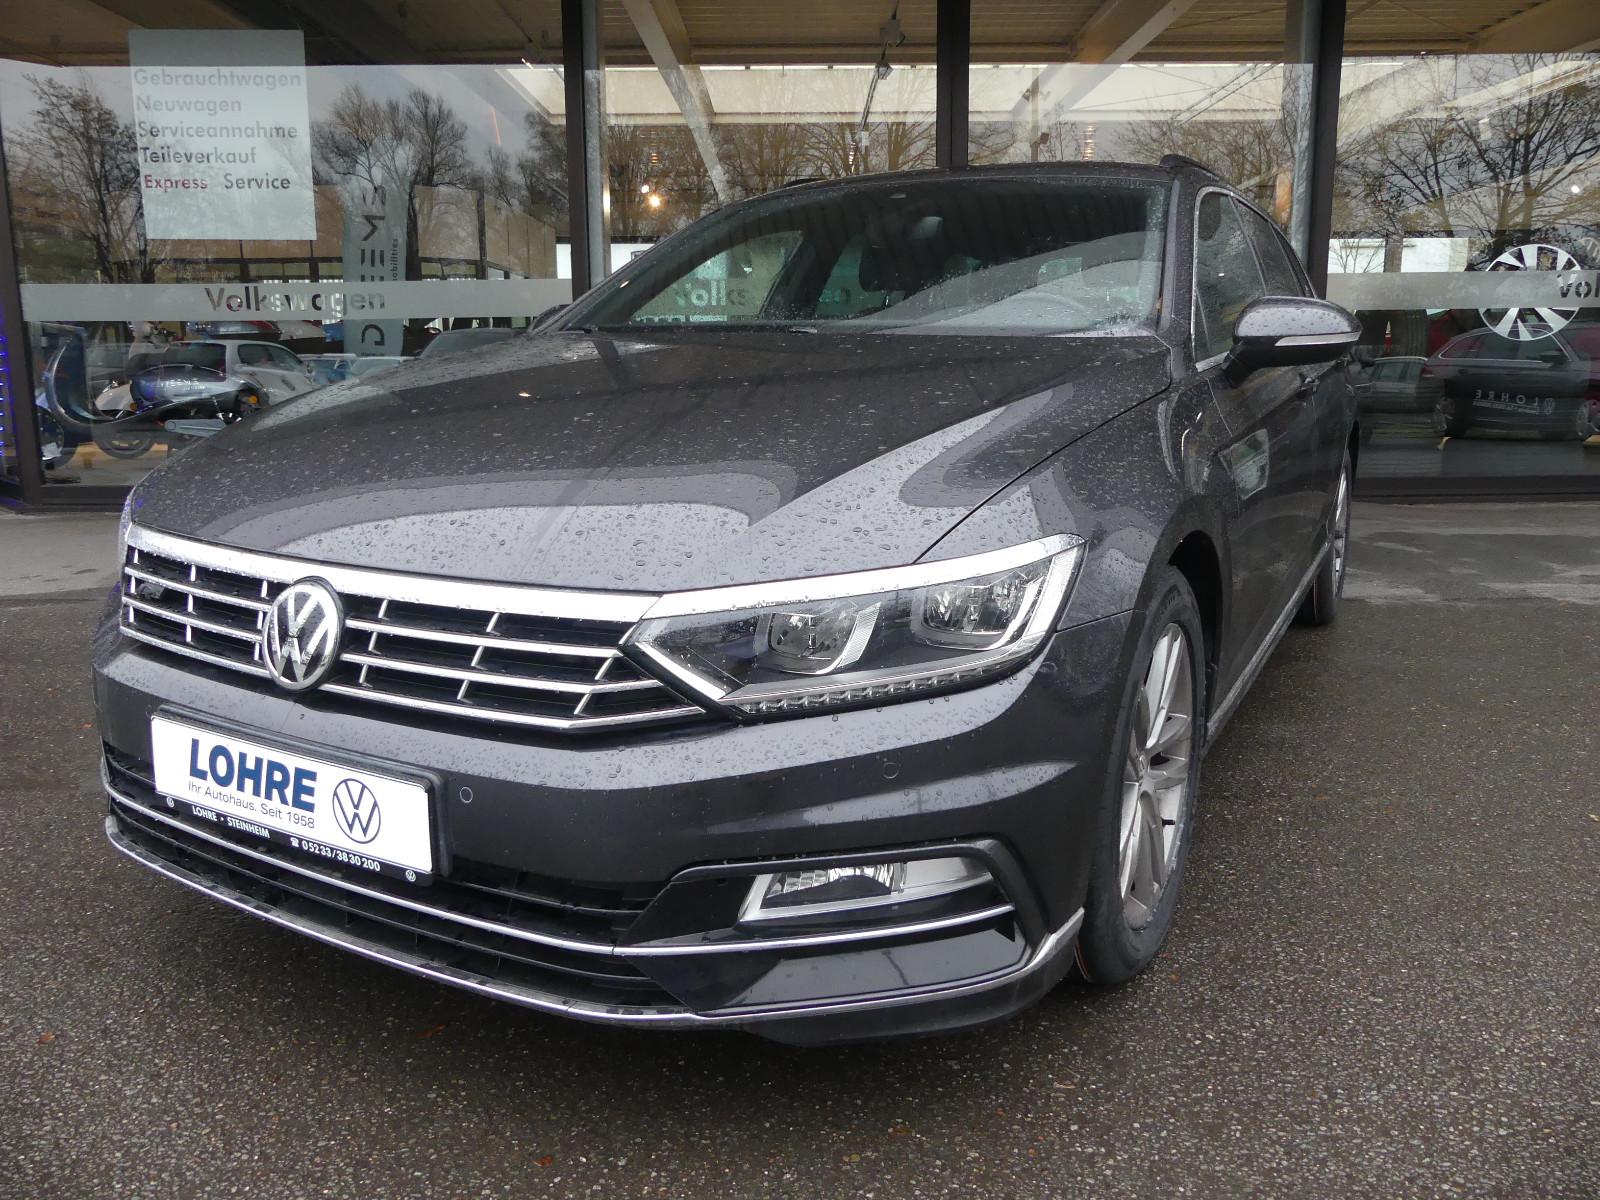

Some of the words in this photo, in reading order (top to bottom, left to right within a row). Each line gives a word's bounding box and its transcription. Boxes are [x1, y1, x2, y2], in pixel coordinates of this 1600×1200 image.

[133, 67, 301, 91] Gebrauchtwagen
[136, 95, 242, 116] Neuwagen
[138, 121, 298, 139] Serviceannahme
[139, 146, 257, 164] Teileverkauf
[144, 174, 208, 193] Express
[223, 173, 291, 190] Service
[204, 286, 385, 316] Volkswagen
[189, 737, 318, 814] LOHRE
[188, 781, 202, 794] Ihr
[204, 786, 257, 813] Autohaus.
[260, 803, 282, 820] Seit
[287, 811, 316, 830] 1958
[191, 805, 218, 822] LOHRE
[227, 816, 271, 839] STEINHEIM
